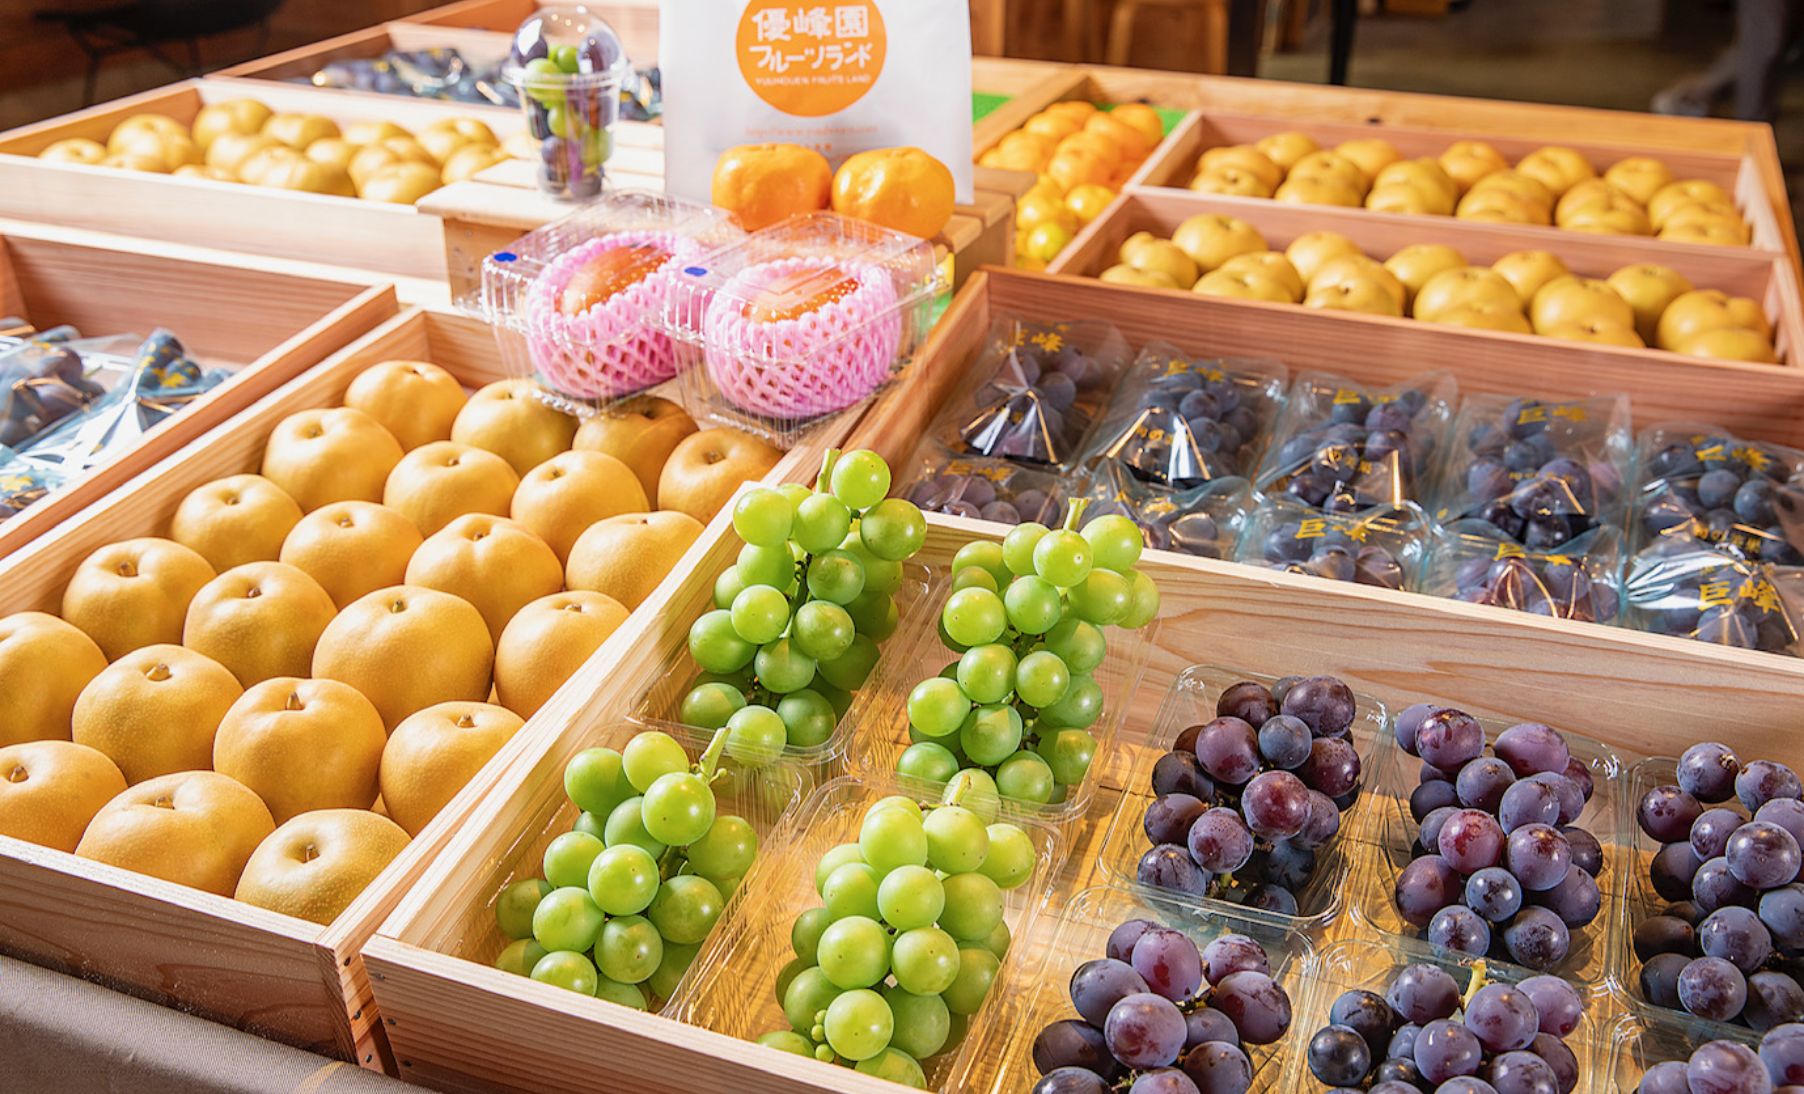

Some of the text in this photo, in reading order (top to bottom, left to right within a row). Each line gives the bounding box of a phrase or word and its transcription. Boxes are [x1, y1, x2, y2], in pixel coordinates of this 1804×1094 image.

[752, 5, 869, 42] 優峰園
[749, 41, 873, 73] フルーツランド
[1697, 578, 1780, 614] 巨峰
